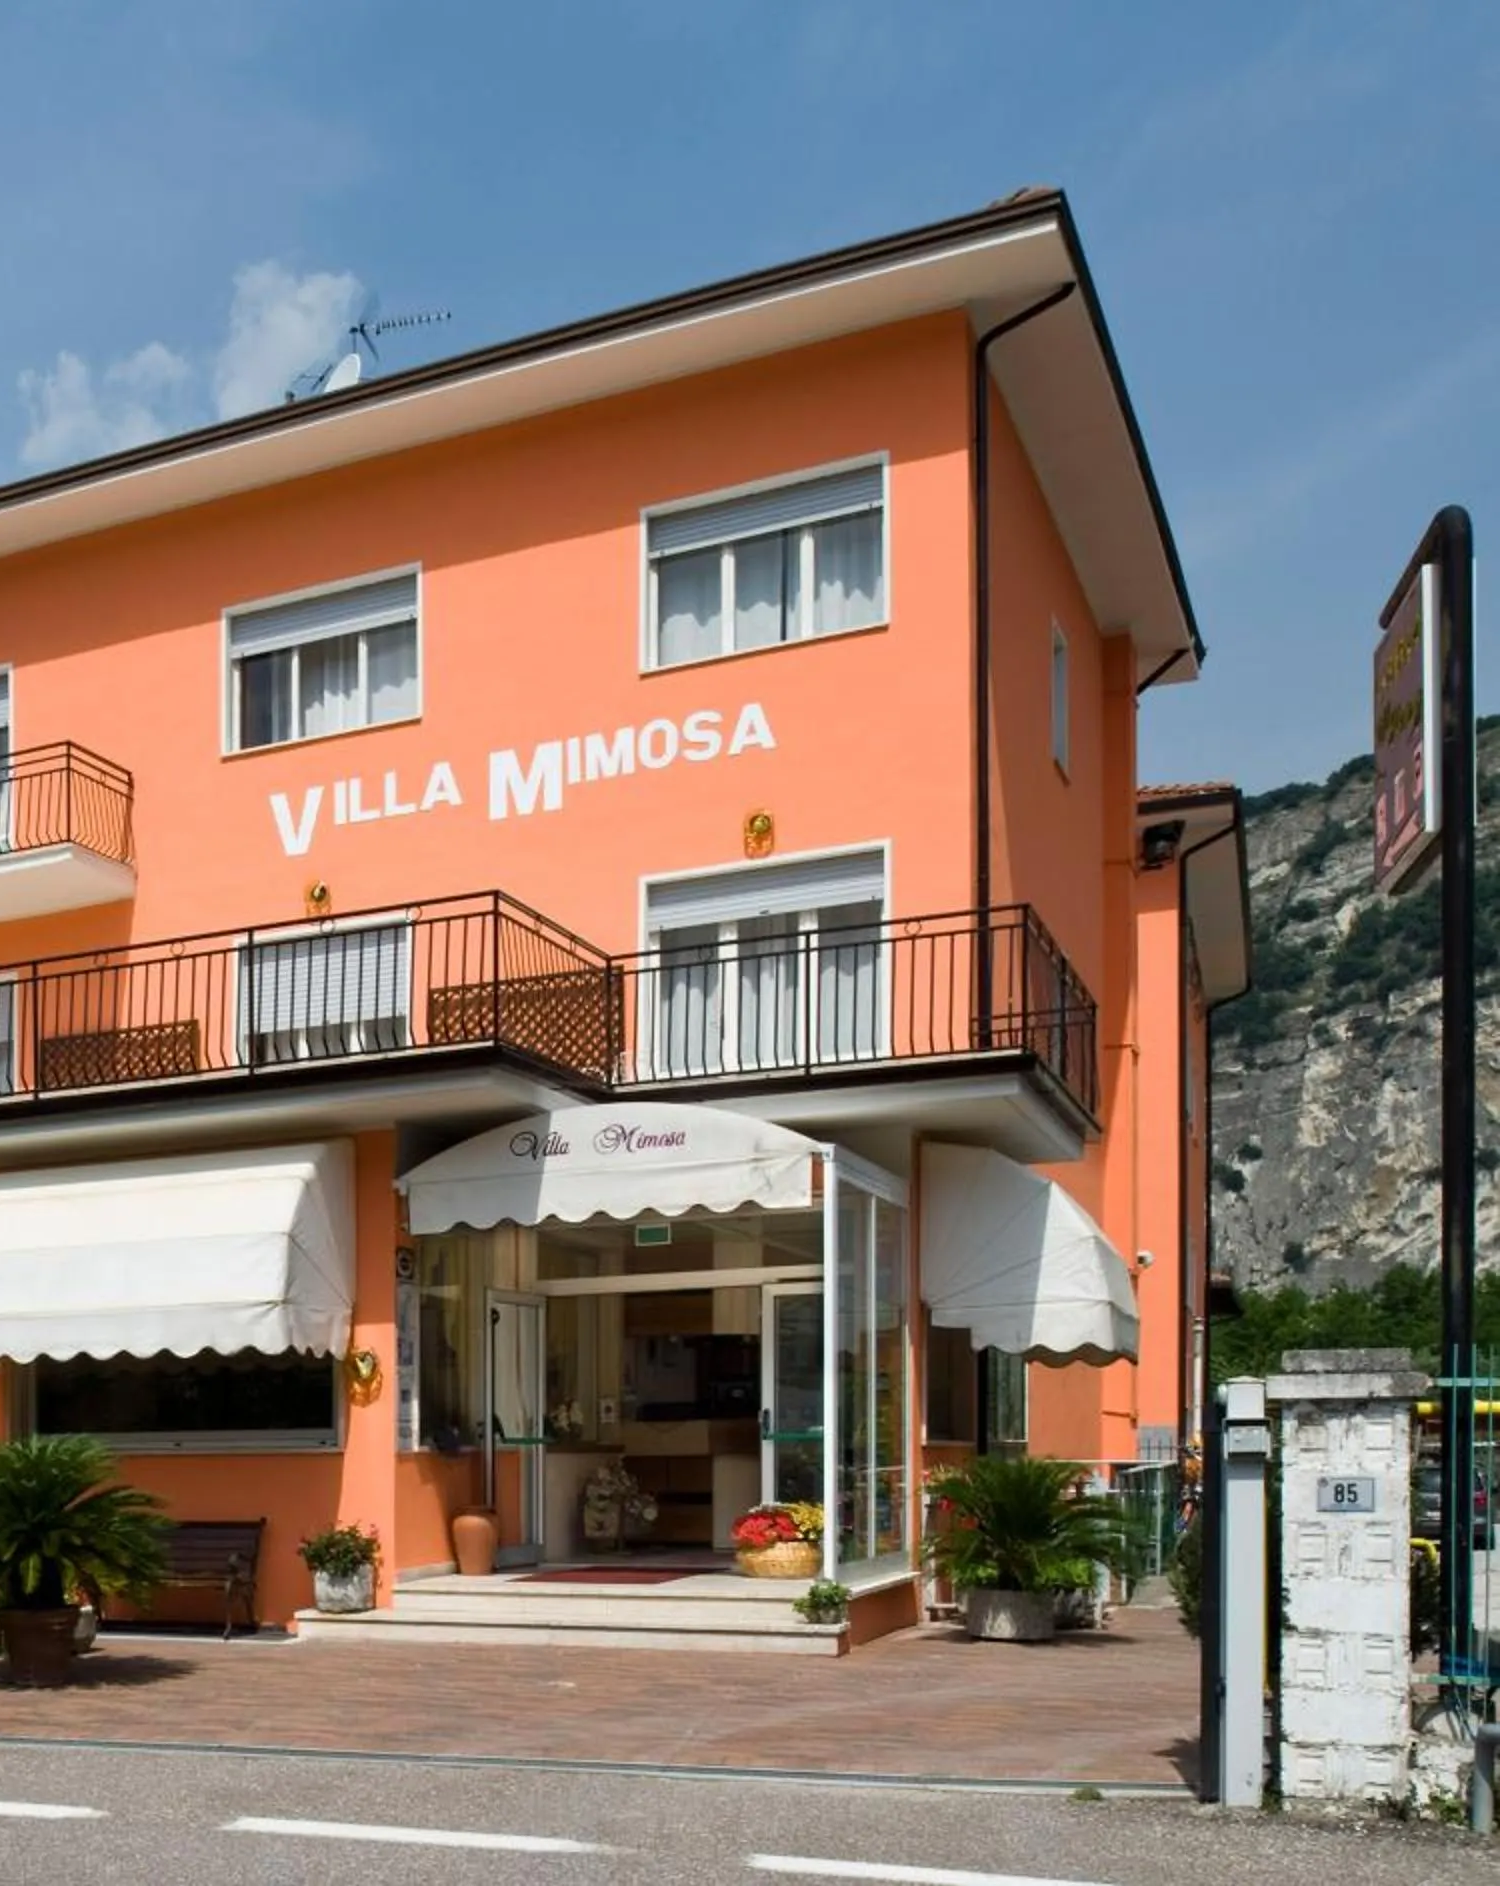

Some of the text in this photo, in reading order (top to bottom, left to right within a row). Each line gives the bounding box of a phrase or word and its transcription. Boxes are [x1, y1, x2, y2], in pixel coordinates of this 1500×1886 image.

[269, 702, 776, 857] VILLA MIMOSA
[509, 1122, 686, 1161] Villa Mimosa
[1333, 1483, 1358, 1504] 85
